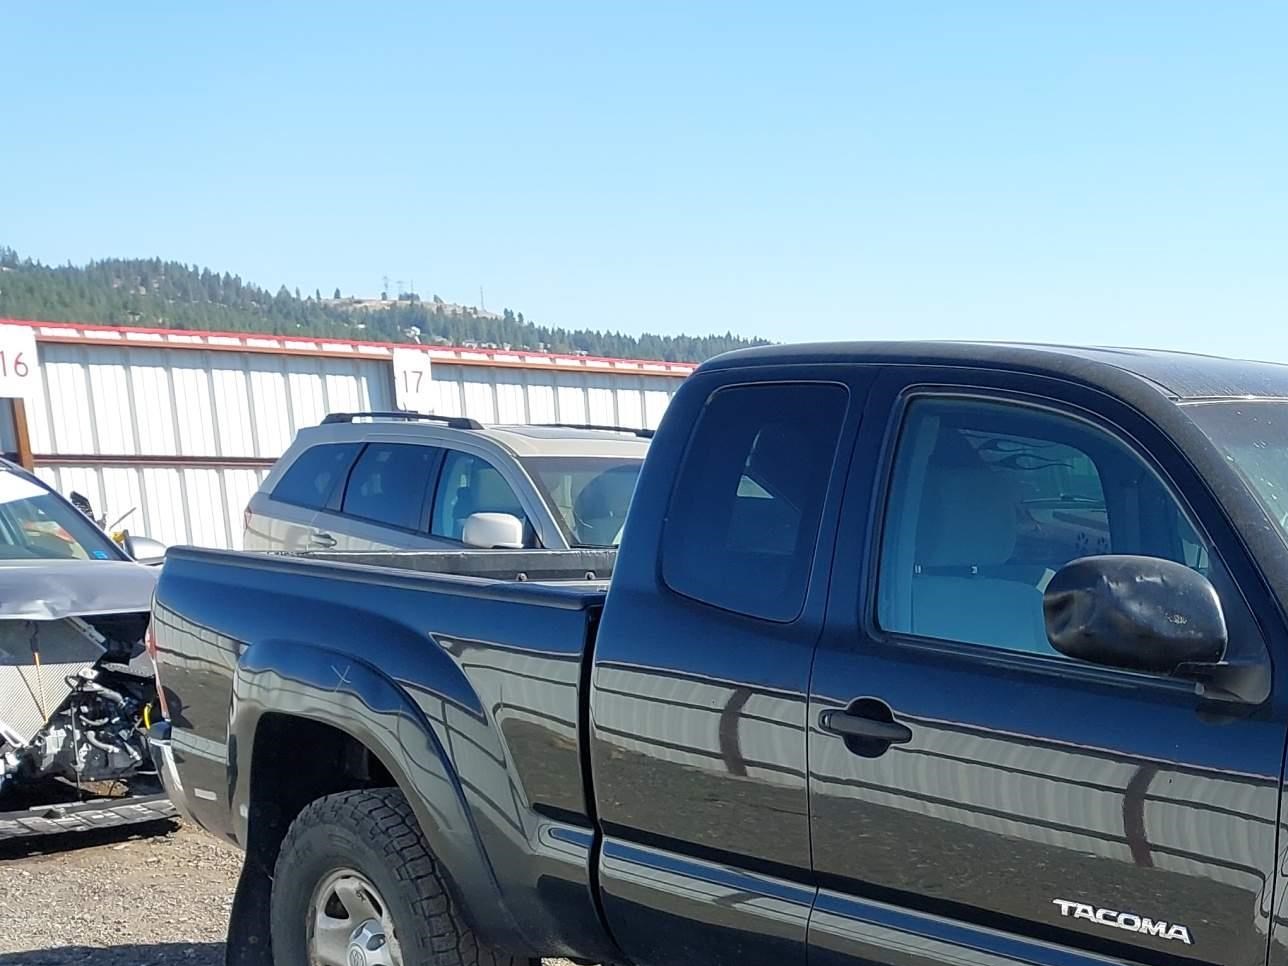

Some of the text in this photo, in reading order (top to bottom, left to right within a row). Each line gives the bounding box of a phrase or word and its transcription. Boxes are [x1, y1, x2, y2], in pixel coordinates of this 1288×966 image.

[0, 350, 29, 377] 16
[403, 370, 423, 393] 17
[1052, 898, 1195, 945] TACOMA
